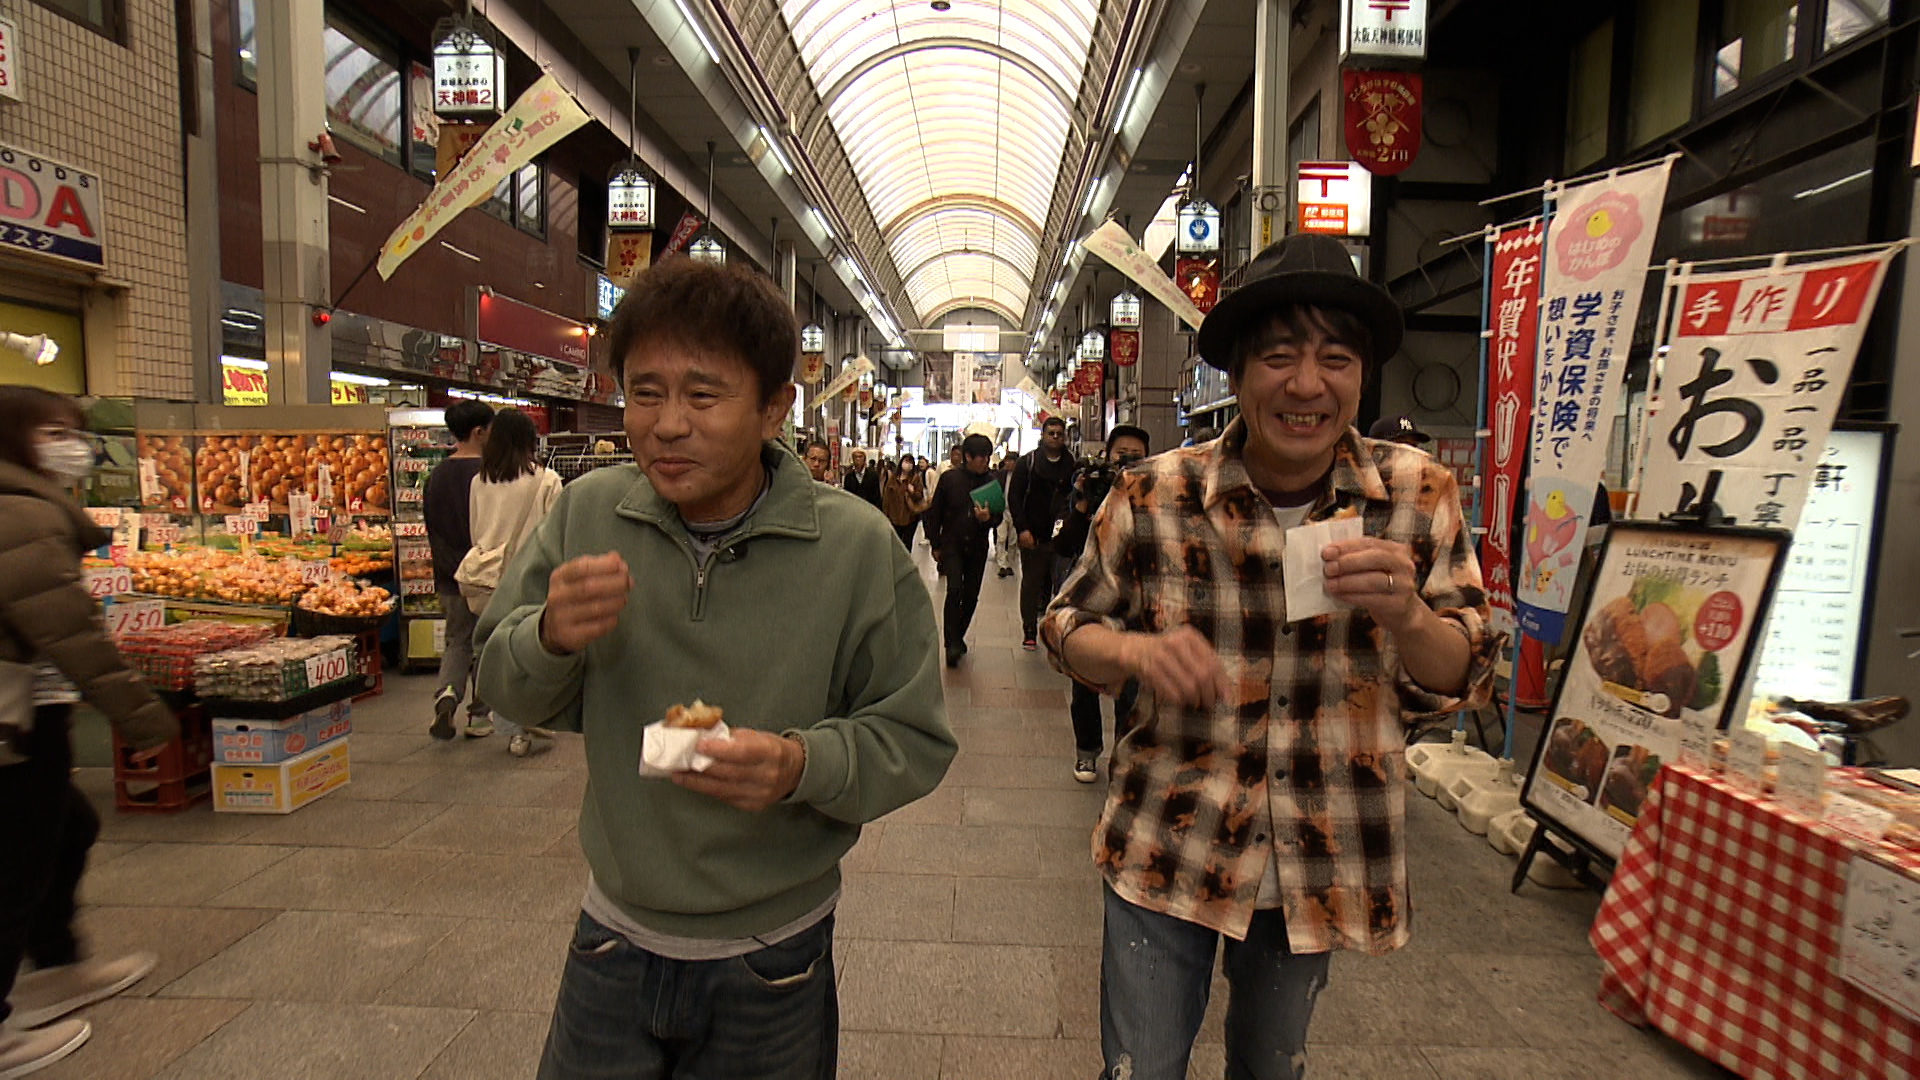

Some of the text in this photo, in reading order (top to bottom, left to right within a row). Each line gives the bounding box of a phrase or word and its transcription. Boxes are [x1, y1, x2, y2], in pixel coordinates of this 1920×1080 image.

[437, 89, 491, 106] 天神橋2
[1687, 276, 1849, 329] 手作り
[1496, 254, 1539, 383] 年賀状
[231, 521, 255, 534] 330
[1696, 554, 1738, 568] MENU
[90, 575, 129, 597] 230
[115, 608, 162, 632] 150
[314, 657, 346, 686] 400
